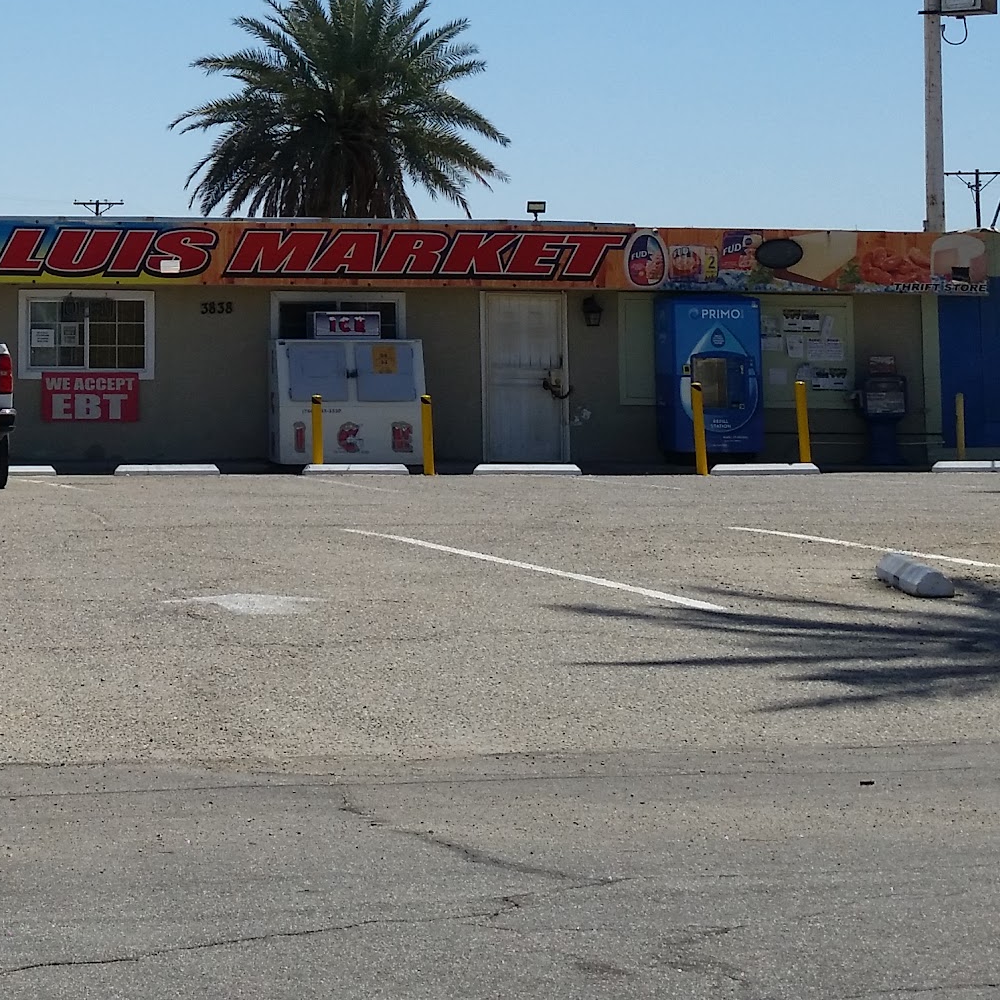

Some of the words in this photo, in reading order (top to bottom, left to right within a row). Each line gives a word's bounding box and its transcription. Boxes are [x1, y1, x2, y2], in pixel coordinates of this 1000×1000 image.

[223, 228, 630, 281] MARKET
[630, 250, 648, 260] FUD
[722, 243, 742, 256] FUD
[707, 256, 715, 269] 2
[894, 283, 940, 291] THRIFT
[944, 283, 987, 292] STORE
[200, 301, 233, 315] 3838
[701, 308, 741, 319] PRIMO
[328, 315, 367, 333] ICE
[45, 377, 71, 391] WE
[73, 377, 136, 391] ACCEPT
[51, 393, 129, 420] EBT
